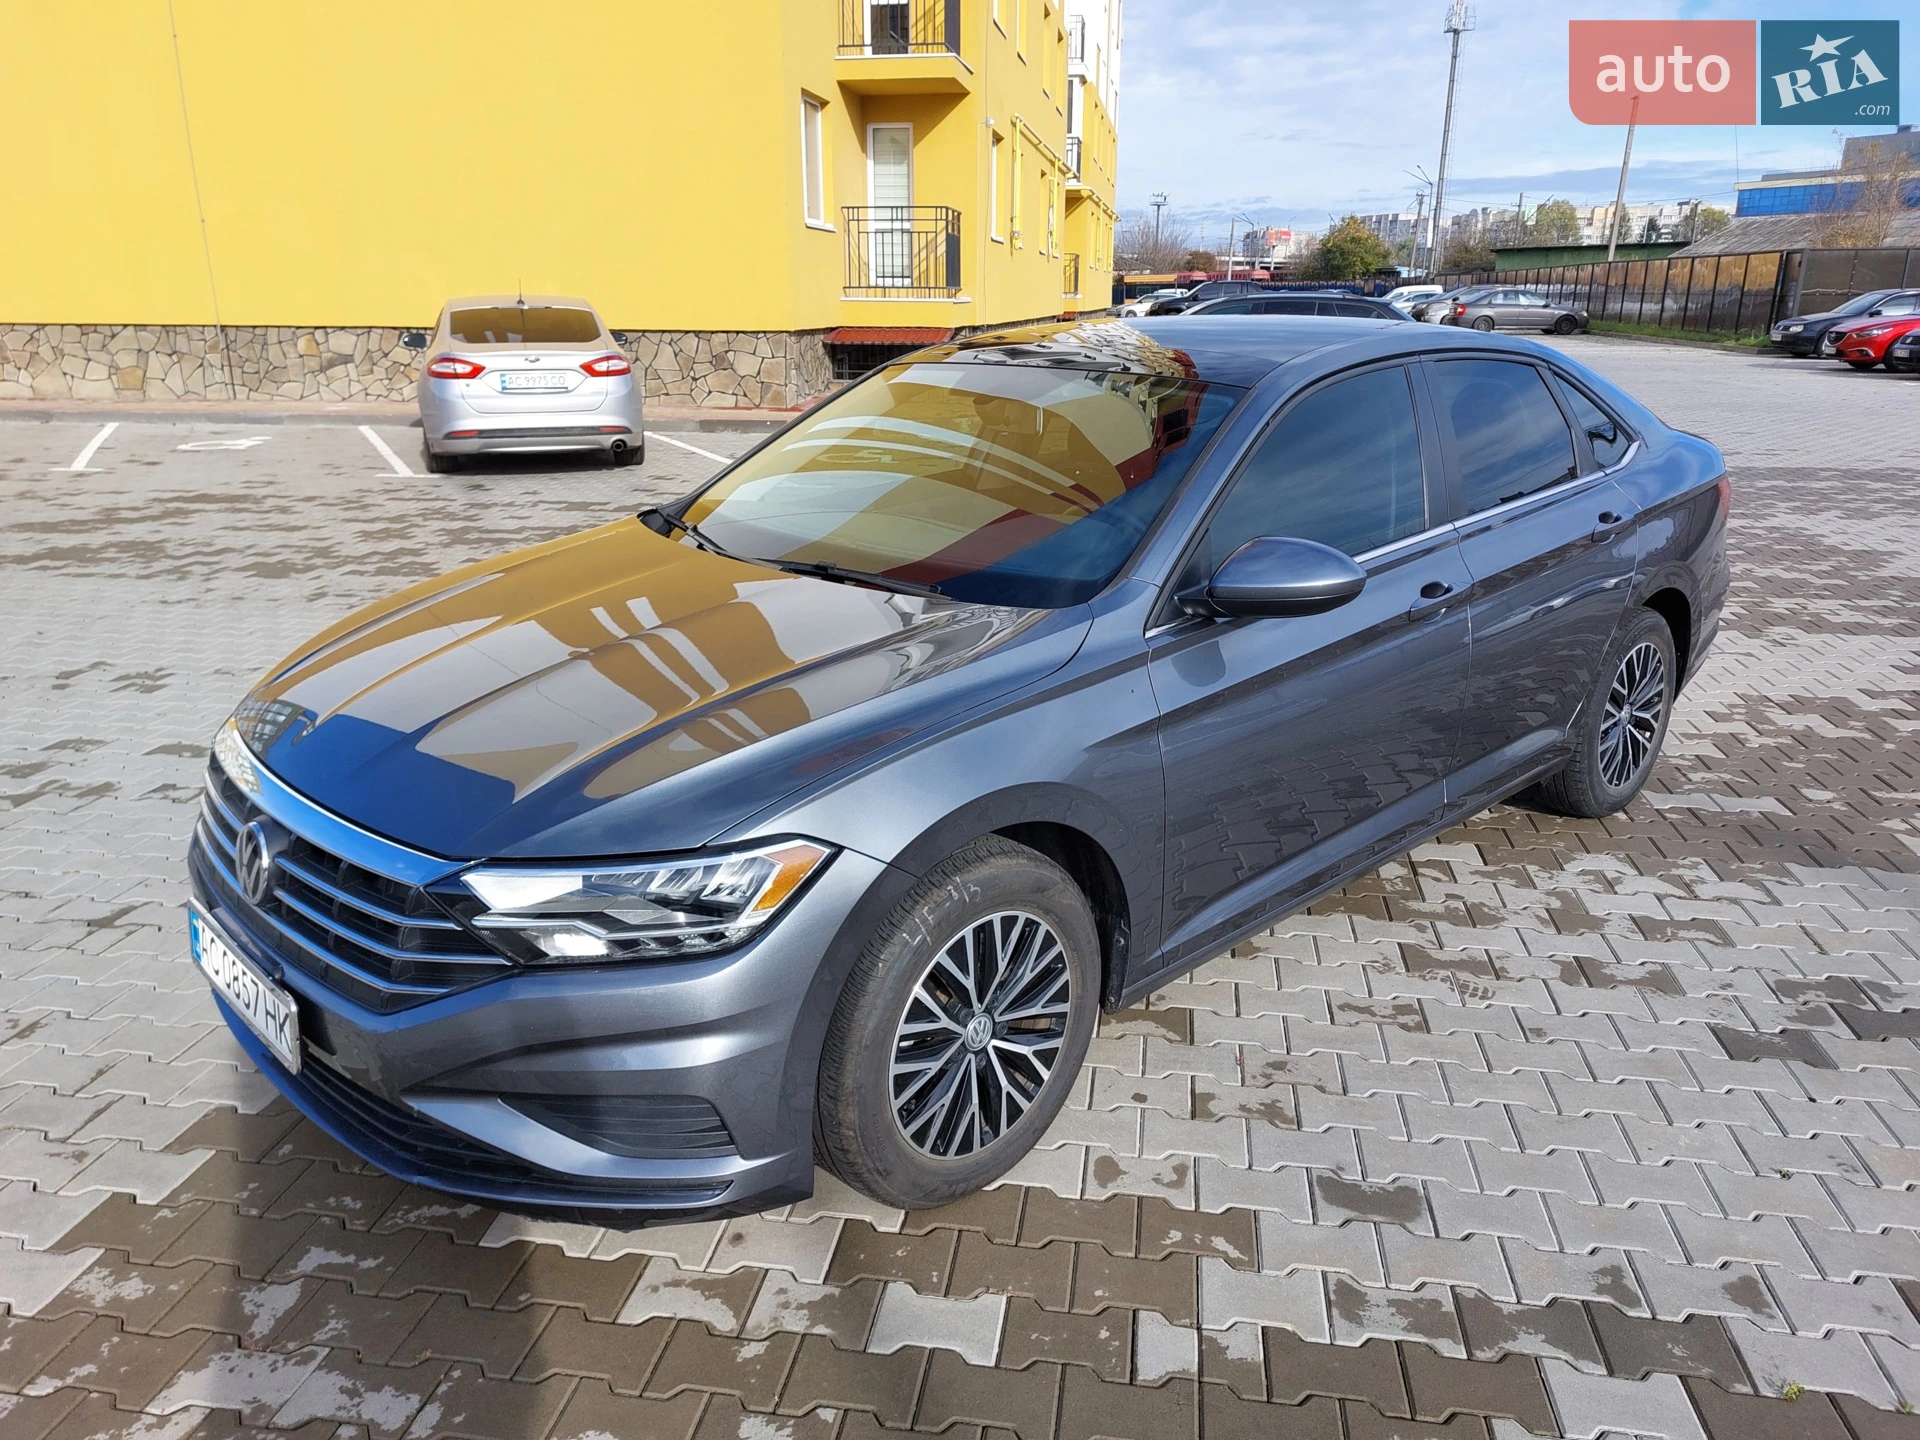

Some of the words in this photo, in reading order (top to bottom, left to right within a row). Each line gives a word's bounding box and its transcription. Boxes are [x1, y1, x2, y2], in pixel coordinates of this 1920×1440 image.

[508, 376, 521, 386] AC
[201, 928, 220, 976] AC
[222, 950, 260, 1018] 0857
[264, 988, 293, 1054] HK
